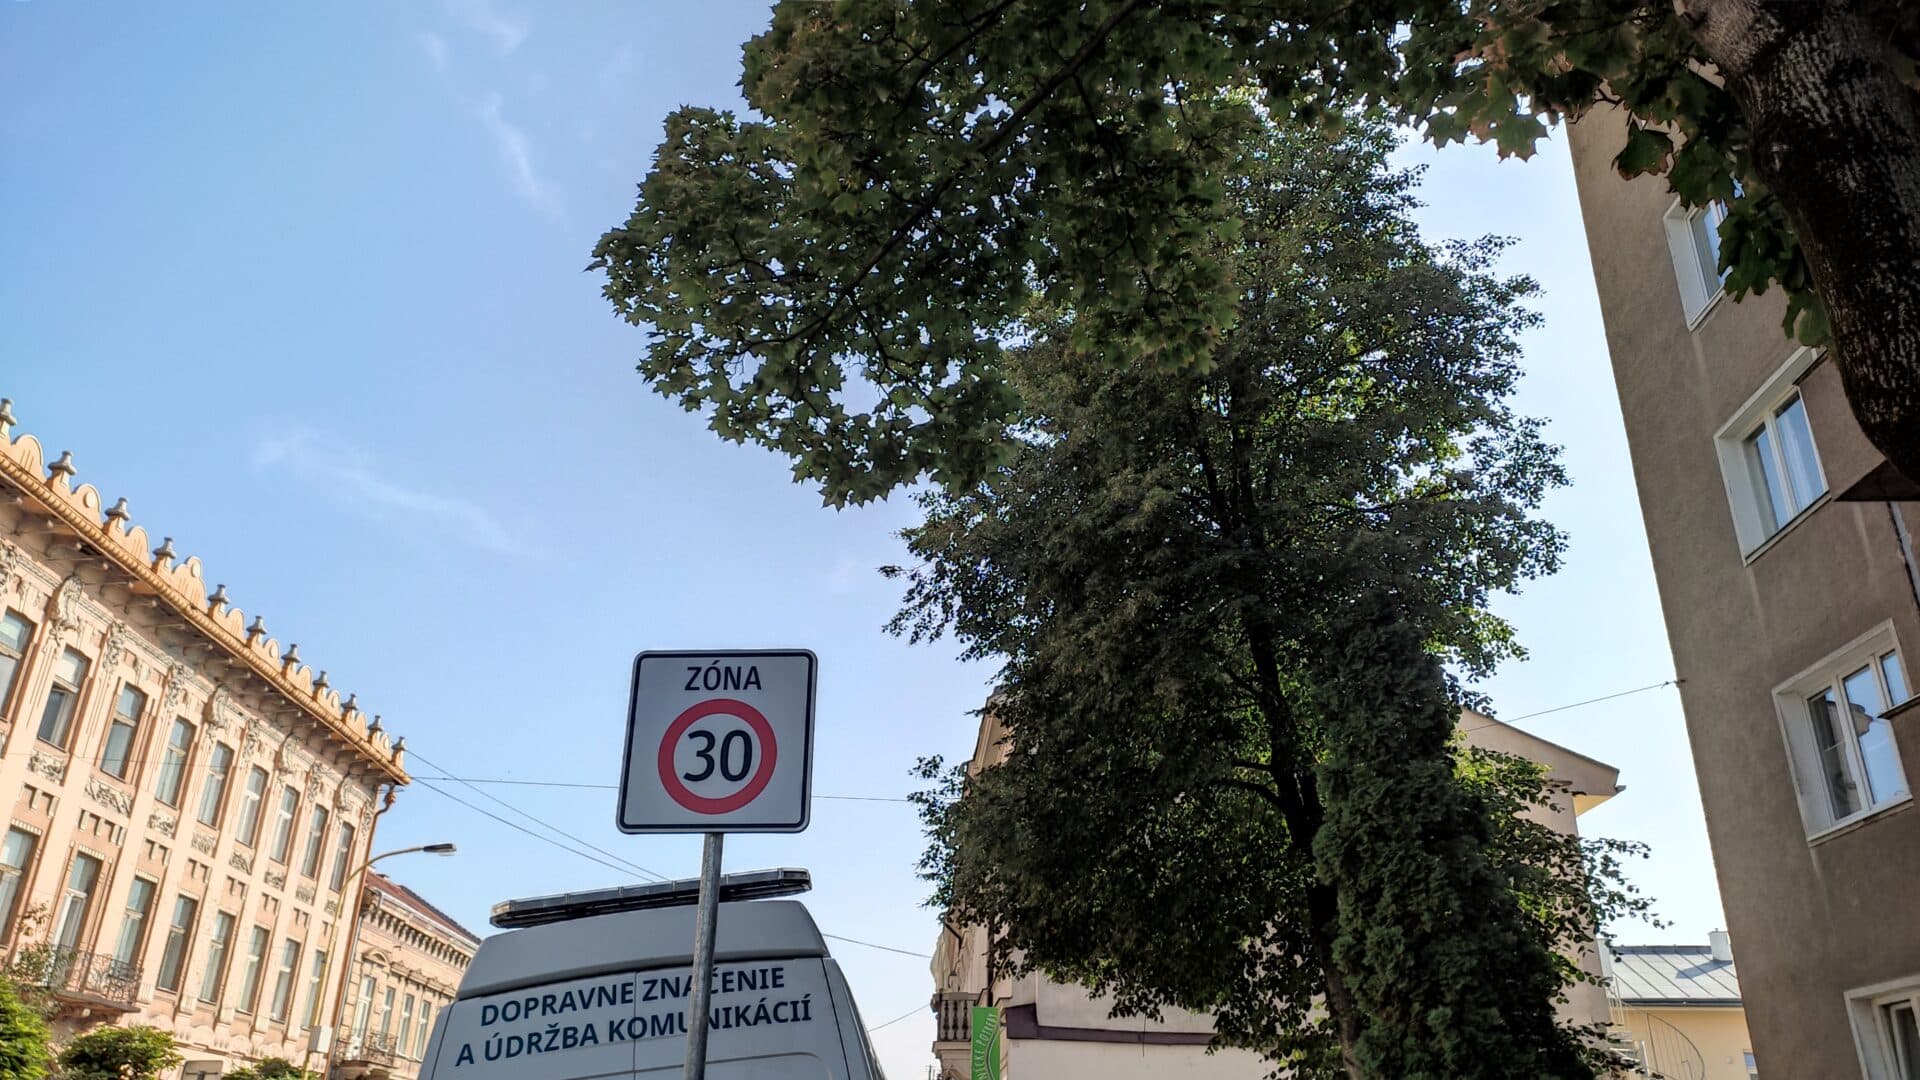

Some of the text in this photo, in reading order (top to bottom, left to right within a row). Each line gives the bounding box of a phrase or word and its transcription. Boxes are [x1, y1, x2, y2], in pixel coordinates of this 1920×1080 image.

[685, 660, 762, 691] ZÓNA
[683, 729, 753, 782] 30
[481, 982, 634, 1027] DOPRAVNE
[455, 1043, 475, 1067] A
[484, 1022, 599, 1061] ÚDRŽBA
